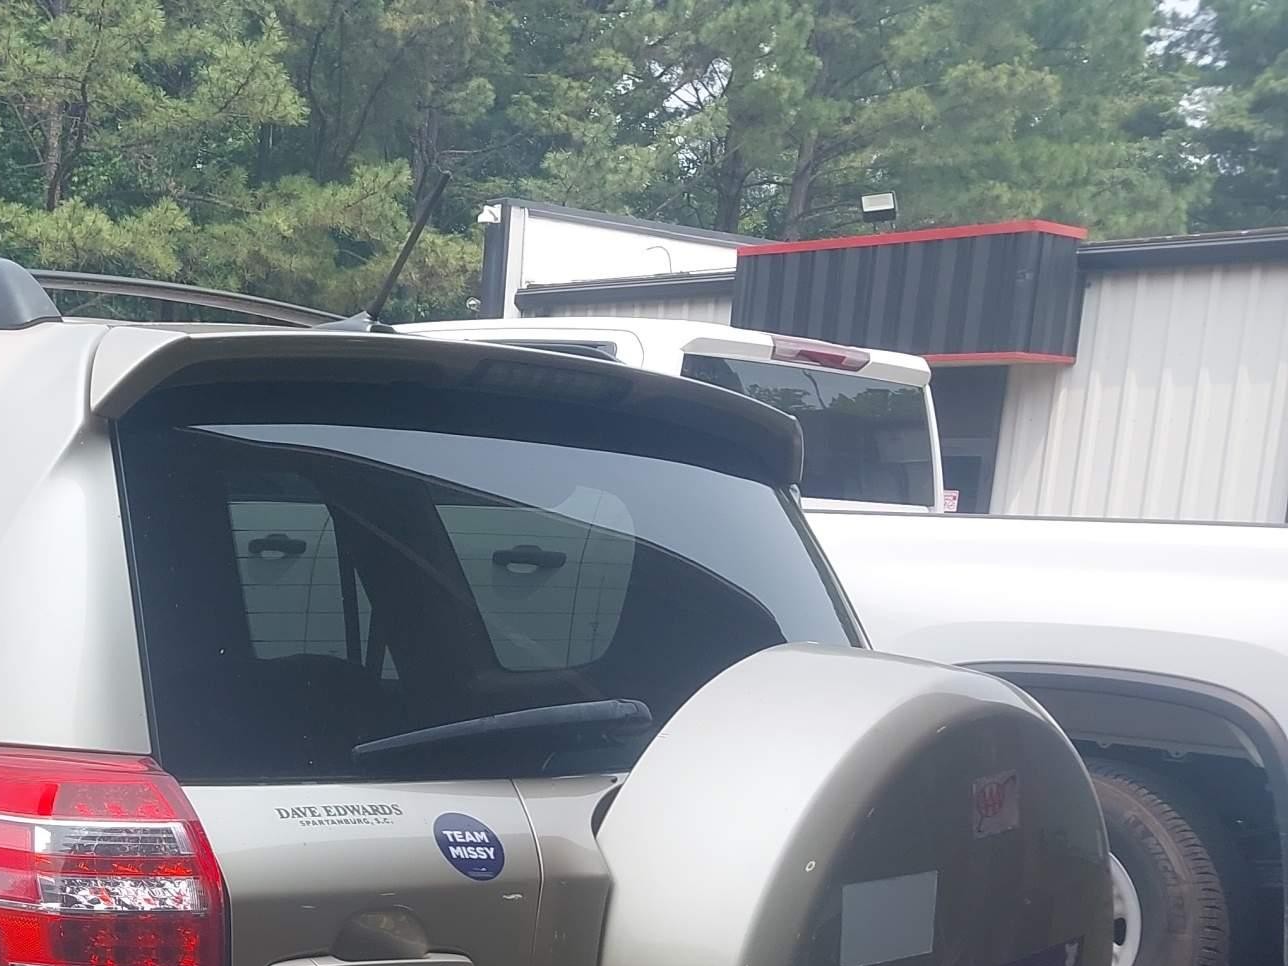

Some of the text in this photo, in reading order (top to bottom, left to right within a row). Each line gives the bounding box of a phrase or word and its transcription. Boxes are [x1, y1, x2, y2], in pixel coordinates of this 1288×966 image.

[275, 803, 404, 820] DAVE EDWARDS
[441, 830, 491, 843] TEAM
[448, 846, 495, 860] MISSY
